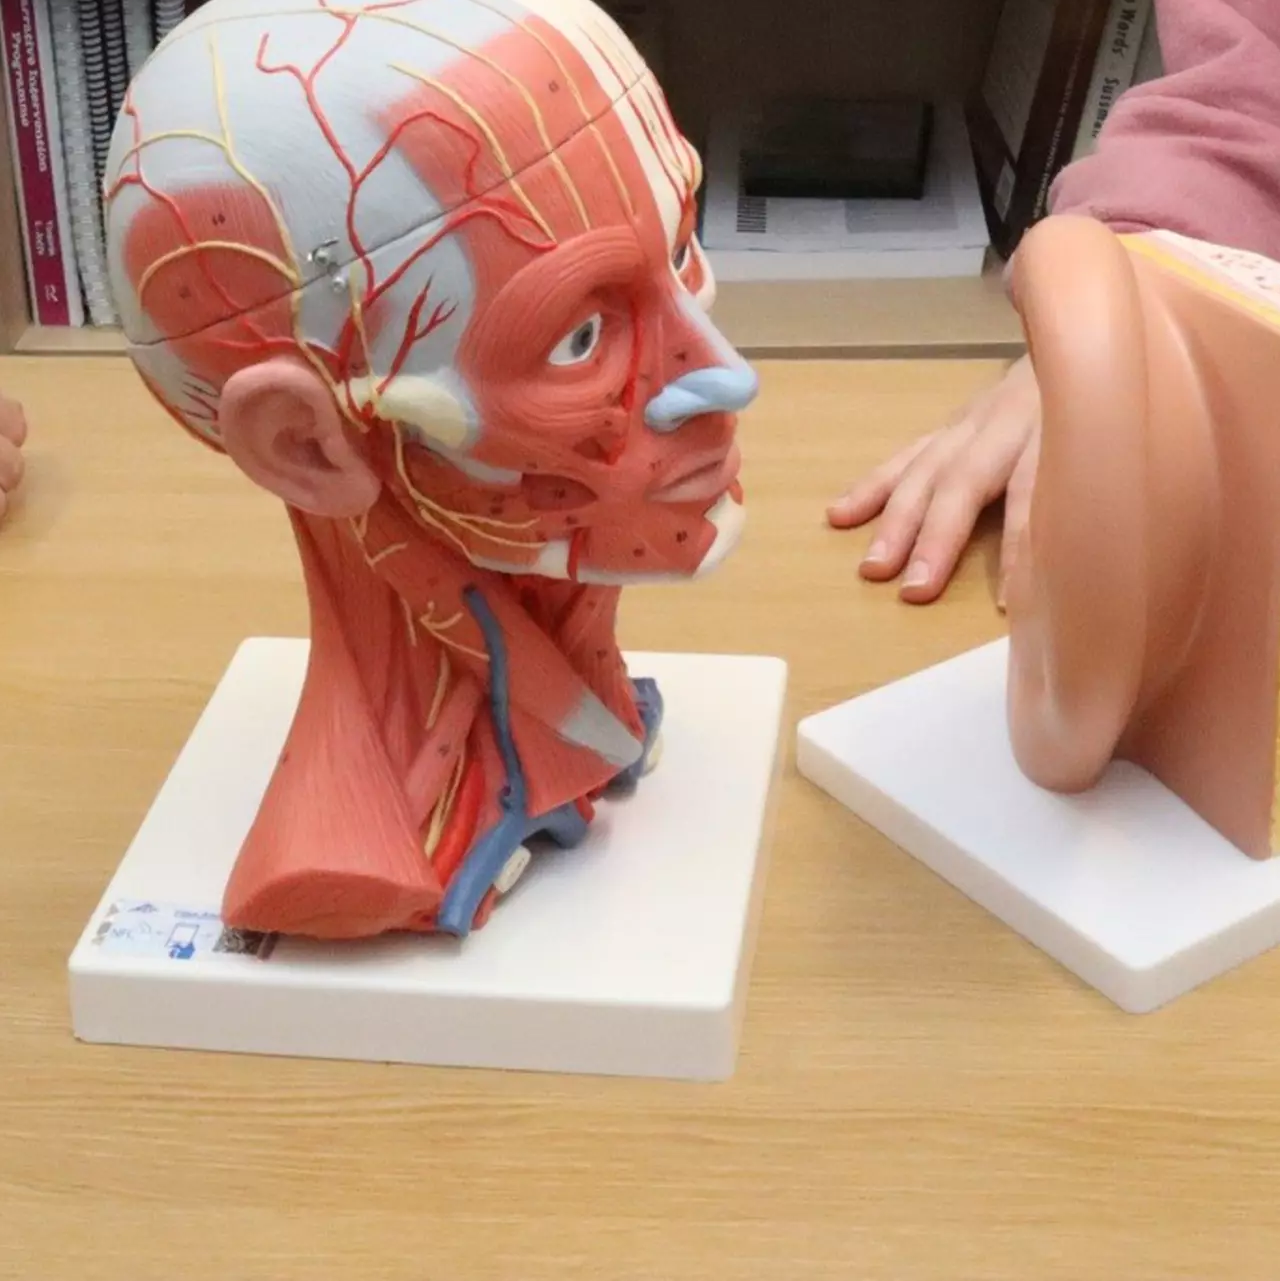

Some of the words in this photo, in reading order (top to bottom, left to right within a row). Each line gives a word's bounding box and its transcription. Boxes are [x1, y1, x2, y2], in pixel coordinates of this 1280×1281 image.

[1110, 5, 1137, 56] Words
[8, 31, 31, 127] Programme
[26, 69, 49, 172] Intervention
